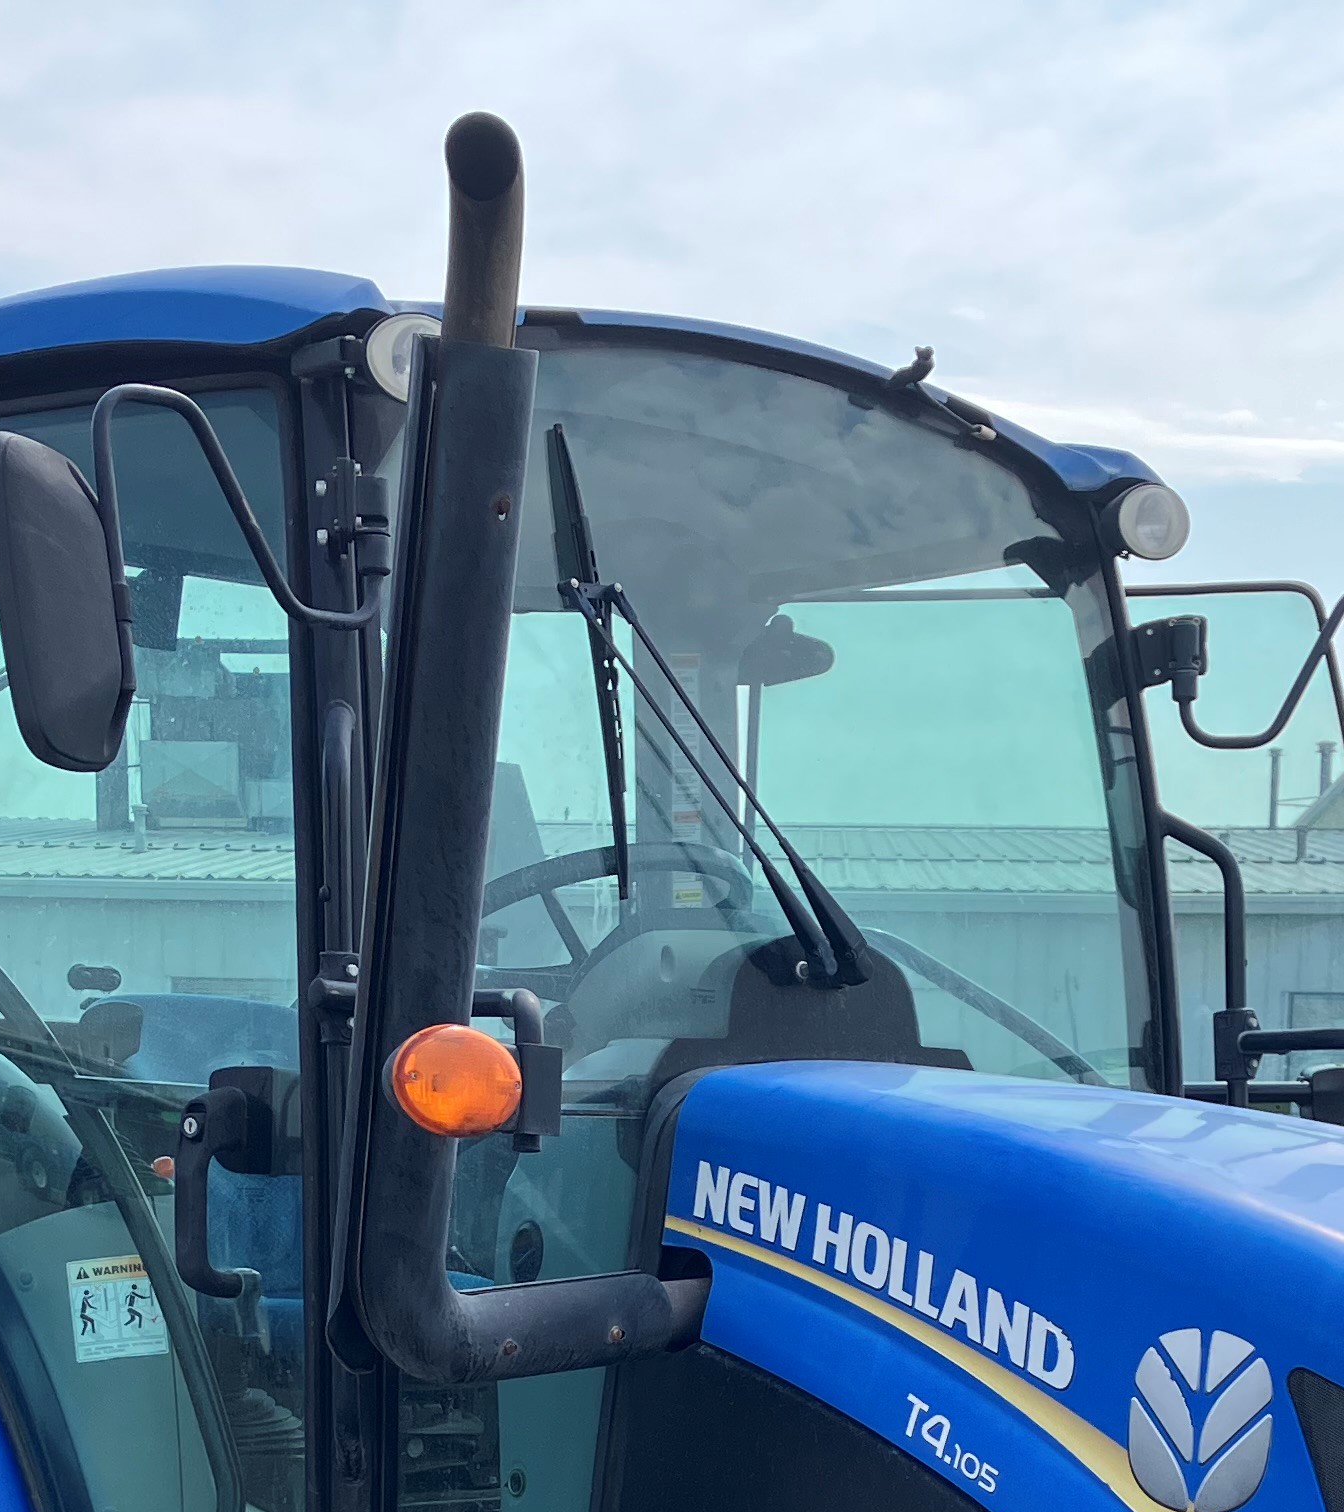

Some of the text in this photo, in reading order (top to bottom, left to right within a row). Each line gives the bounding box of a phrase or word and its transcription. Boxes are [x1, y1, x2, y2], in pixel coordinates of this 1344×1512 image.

[92, 1263, 145, 1276] WARNIN
[693, 1160, 1075, 1391] NEW HOLLAND
[905, 1393, 999, 1493] T4.105
